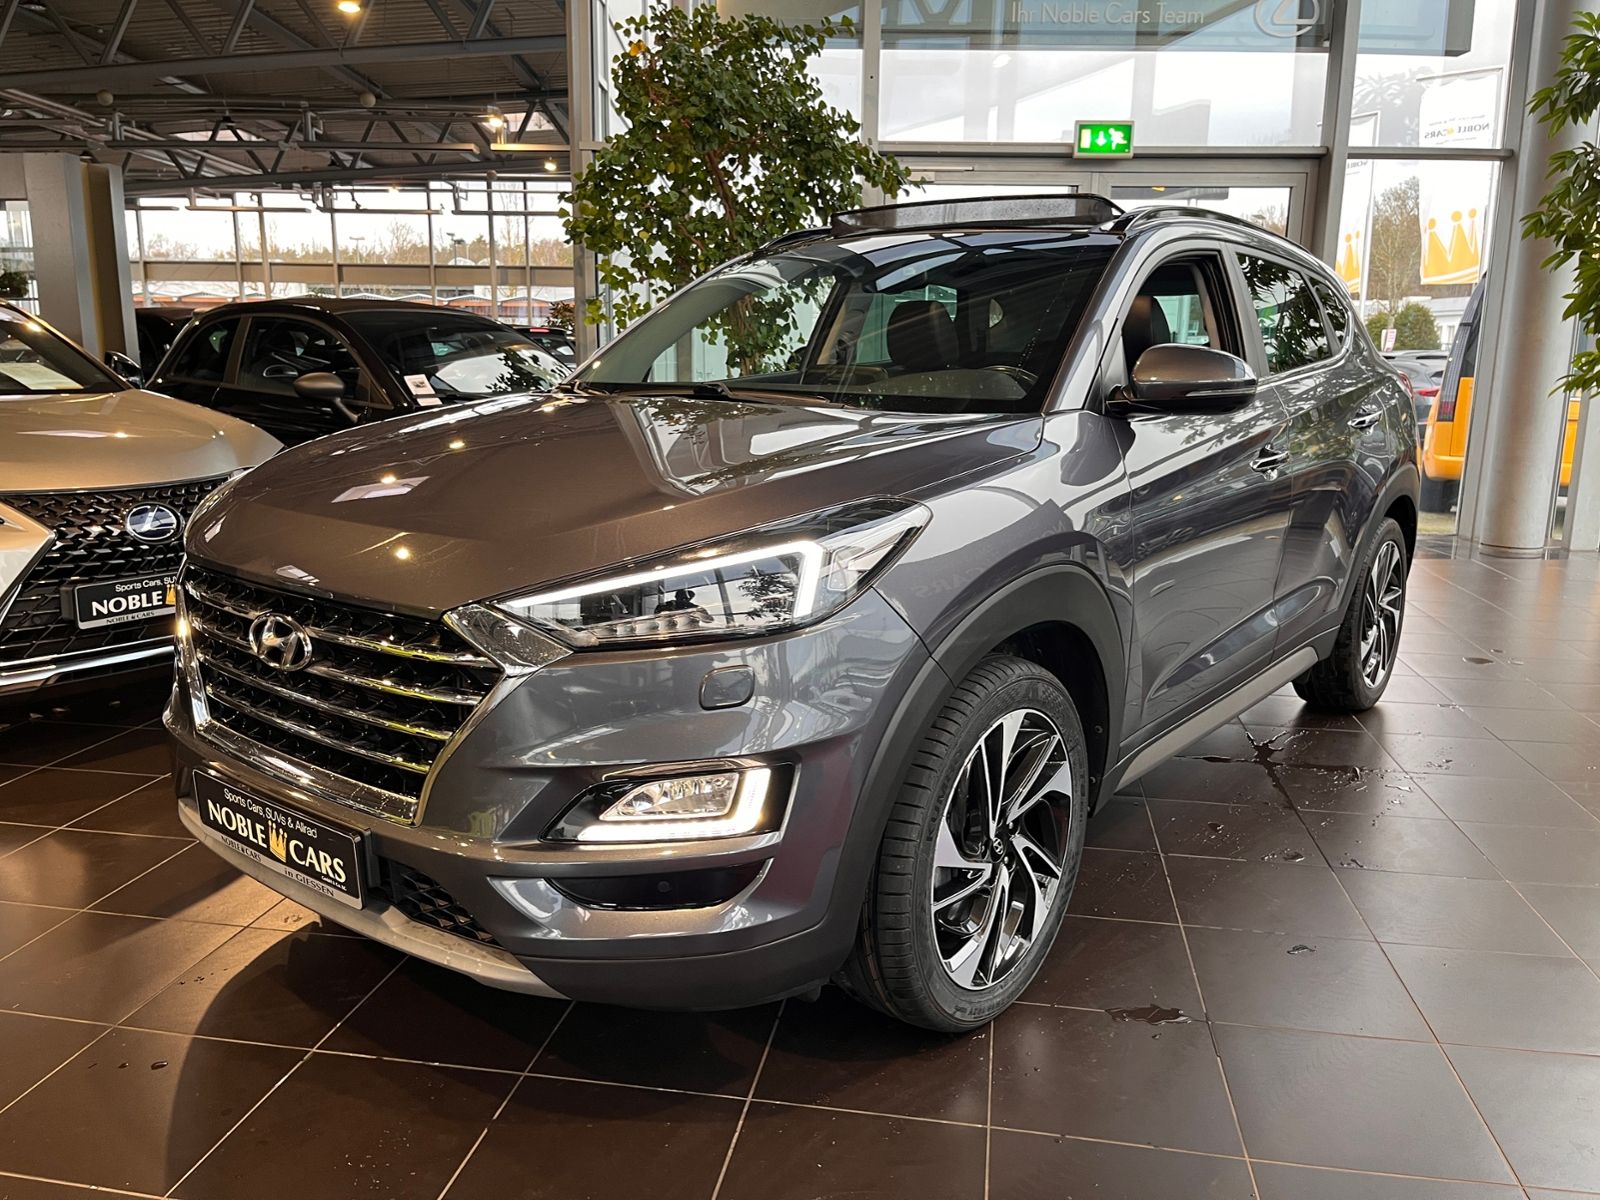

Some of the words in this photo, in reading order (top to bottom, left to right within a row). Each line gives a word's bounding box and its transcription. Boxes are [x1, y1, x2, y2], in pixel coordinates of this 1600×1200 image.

[1011, 1, 1034, 24] Ihr
[1041, 1, 1099, 24] Noble
[1105, 2, 1150, 24] Cars
[1157, 2, 1204, 24] Team
[115, 583, 142, 593] Sports
[91, 590, 163, 617] NOBLE
[224, 788, 247, 808] Sports
[246, 799, 266, 818] Cars,
[265, 807, 287, 826] SUVs
[287, 816, 295, 829] &
[295, 820, 318, 839] Allrad
[207, 799, 268, 849] NOBLE
[289, 839, 347, 884] CARS
[284, 867, 294, 879] in
[295, 872, 335, 897] GIESSEN
